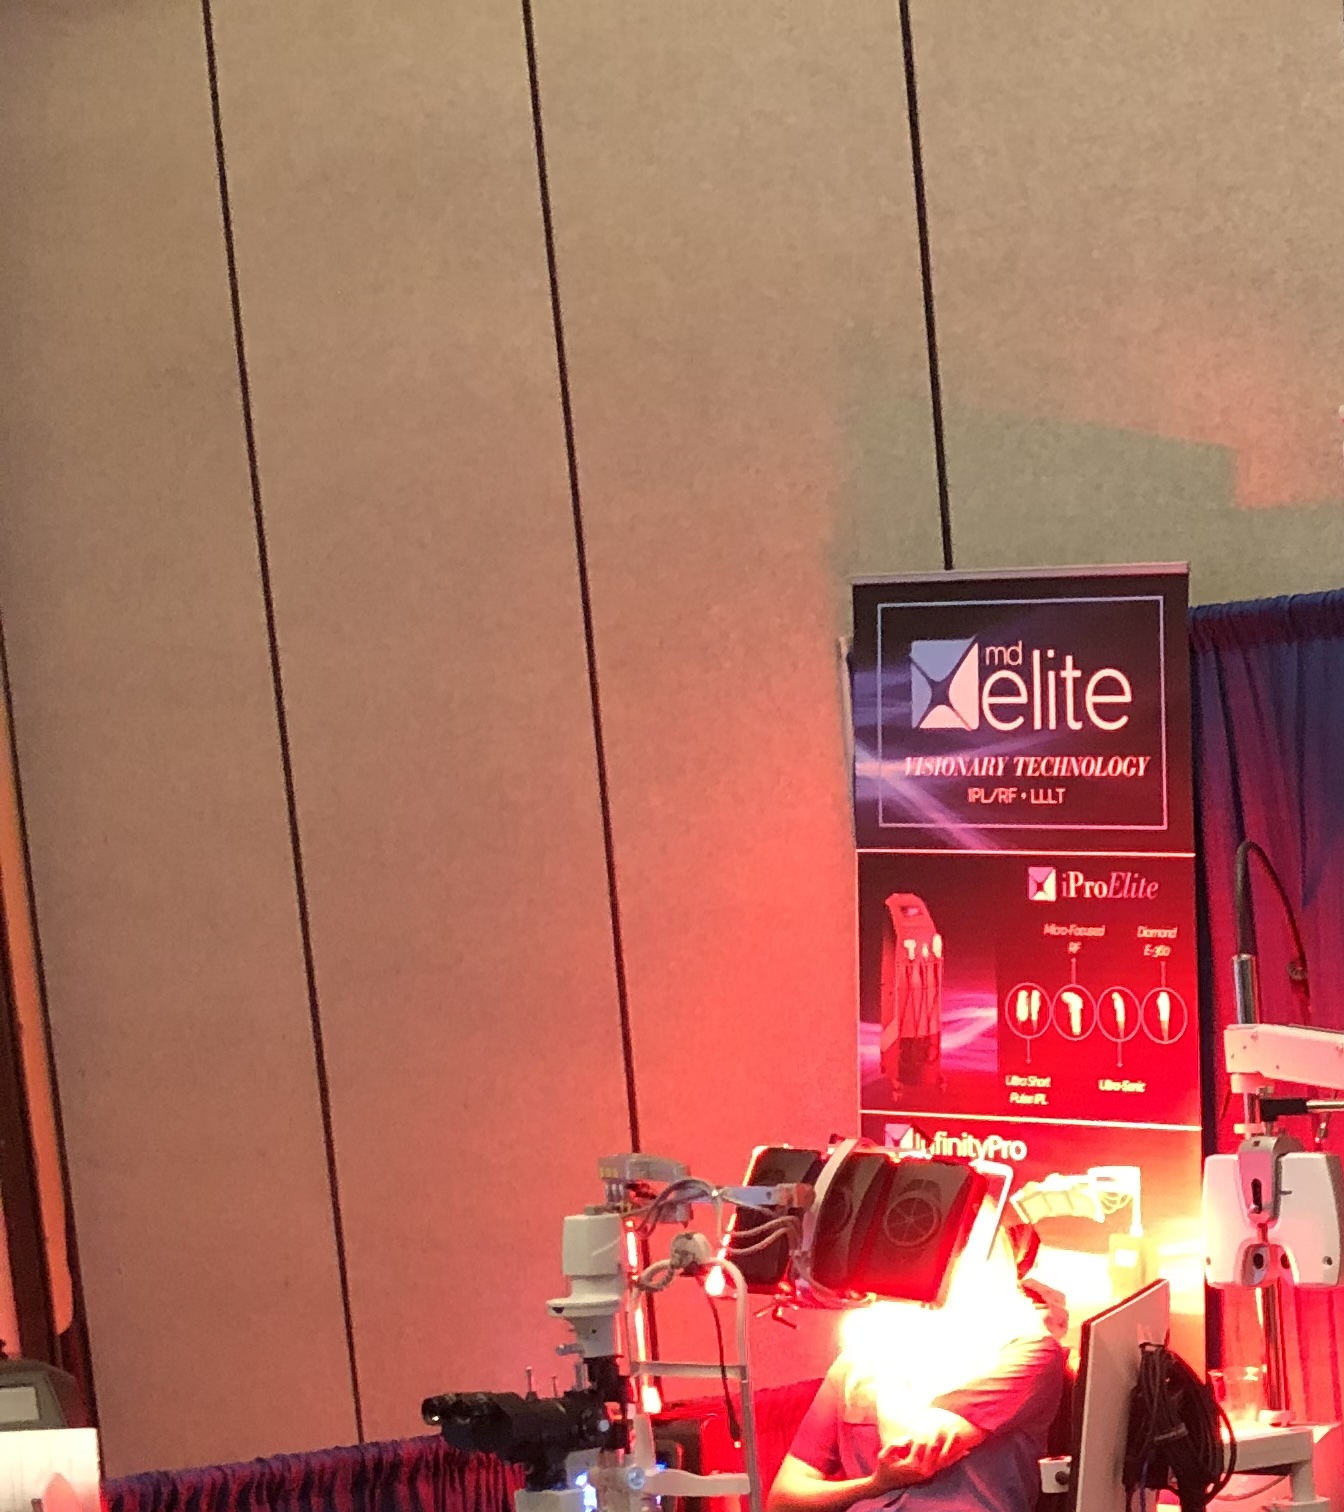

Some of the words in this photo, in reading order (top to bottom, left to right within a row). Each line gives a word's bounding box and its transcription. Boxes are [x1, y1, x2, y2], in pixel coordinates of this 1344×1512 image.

[985, 640, 1022, 666] md
[982, 650, 1133, 731] elite
[904, 756, 1009, 777] VISIONARY
[1014, 756, 1151, 777] TECHNOLOGY
[968, 787, 1018, 804] IPL/RF
[1030, 788, 1066, 804] LLLT
[1062, 871, 1159, 899] iProElite
[1136, 926, 1178, 939] Diamond
